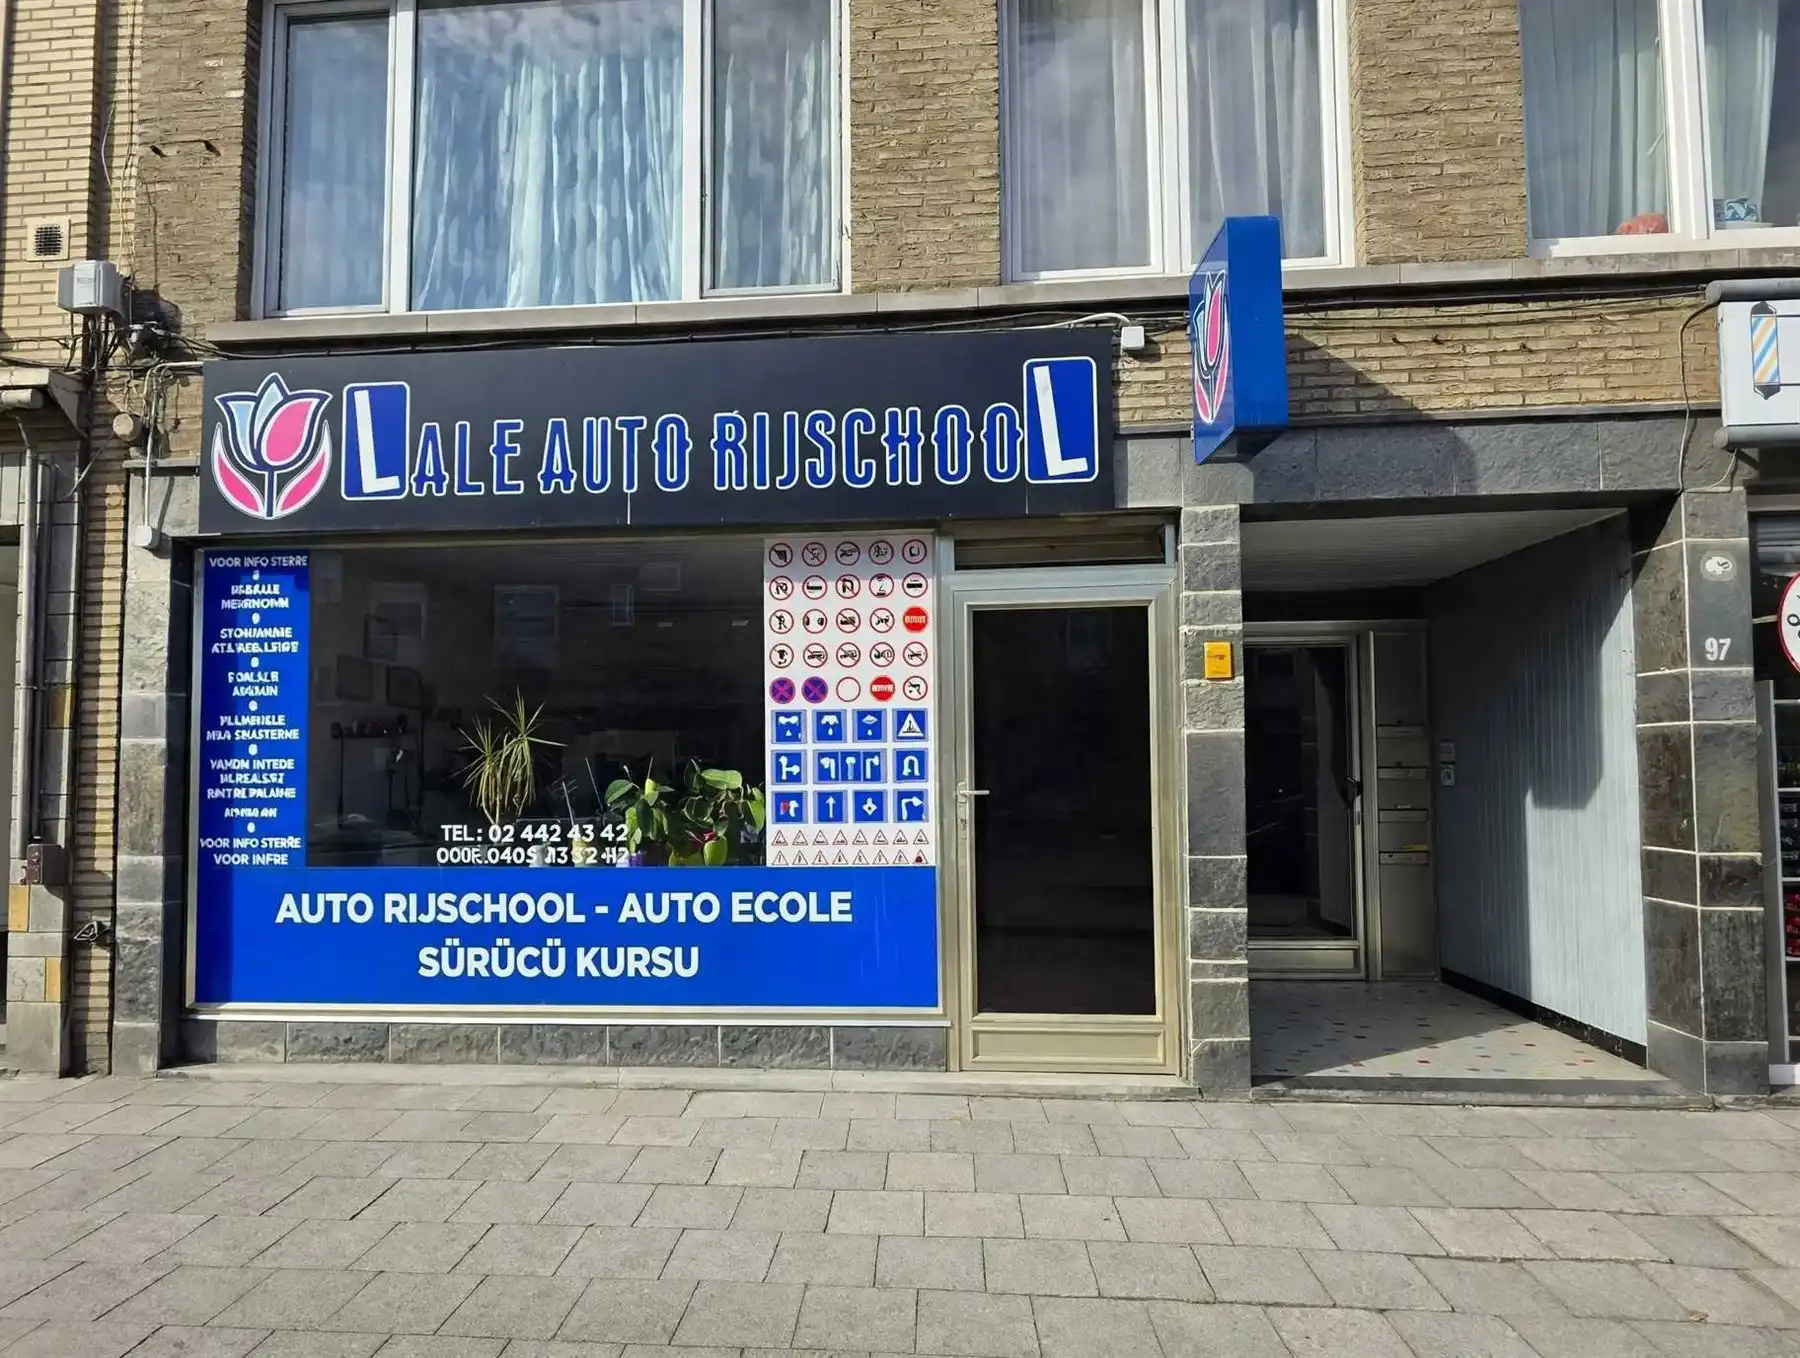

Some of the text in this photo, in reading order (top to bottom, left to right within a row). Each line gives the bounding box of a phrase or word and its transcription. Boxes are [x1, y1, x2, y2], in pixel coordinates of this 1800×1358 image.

[343, 356, 1099, 499] LALE AUTO RIJSCHOOL
[209, 557, 241, 567] VOOR
[243, 556, 269, 567] INFO
[1705, 637, 1732, 661] 97
[200, 838, 230, 848] VOOR
[233, 838, 259, 848] INFO
[441, 824, 629, 842] TEL: 02 442 43 42
[213, 854, 249, 865] VOOR
[275, 893, 374, 924] AUTO
[384, 892, 586, 924] RIJSCHOOL
[617, 892, 720, 923] AUTO
[731, 891, 853, 922] ECOLE
[418, 938, 699, 978] SÜRÜCÜ KURSU
